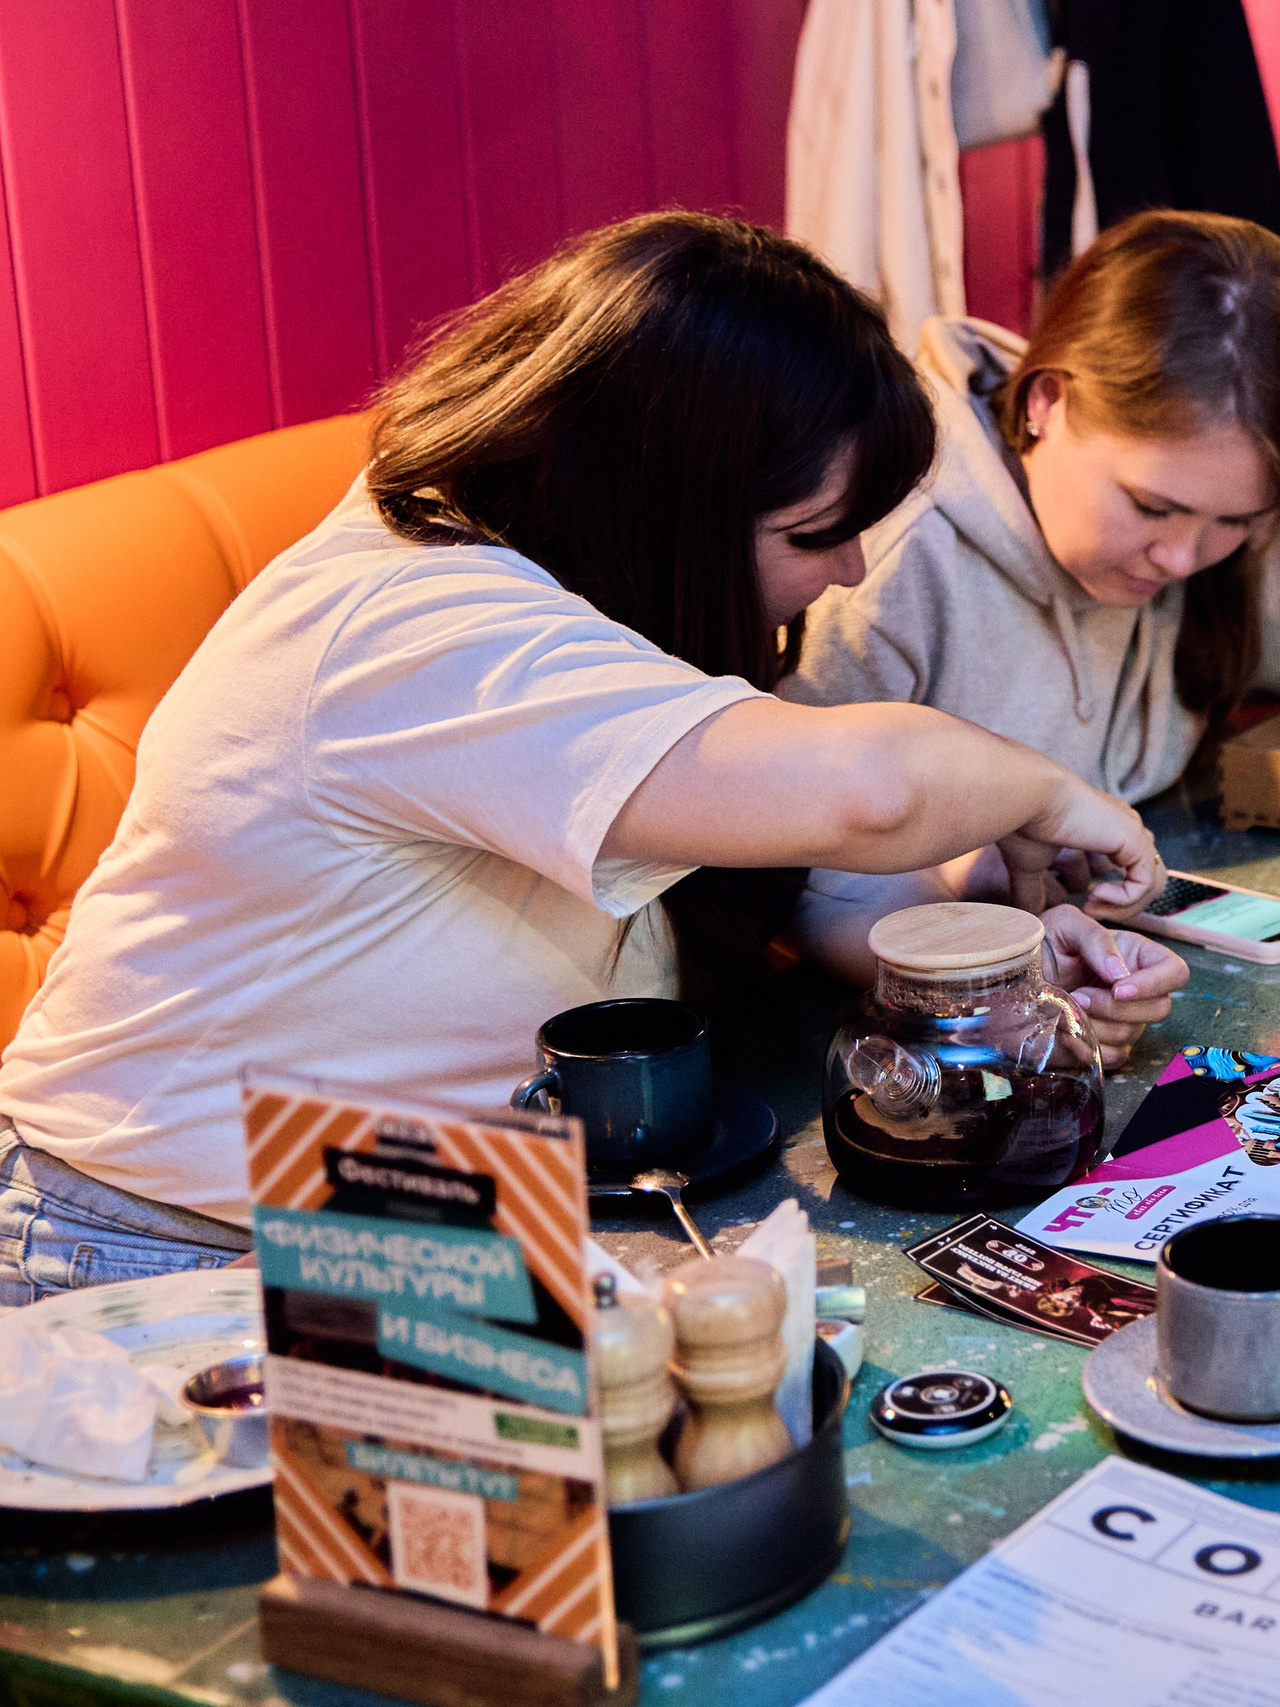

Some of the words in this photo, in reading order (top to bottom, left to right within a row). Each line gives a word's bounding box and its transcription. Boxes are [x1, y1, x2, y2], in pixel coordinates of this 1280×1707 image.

[1133, 1165, 1246, 1251] СЕРТИФИКАТ
[262, 1219, 517, 1281] ФИЗИЧЕСКОЙ
[300, 1256, 486, 1305] КУЛЬТУРЫ
[380, 1312, 410, 1344] И
[414, 1321, 579, 1396] БИЗНЕСА
[1192, 1601, 1278, 1633] BAR
